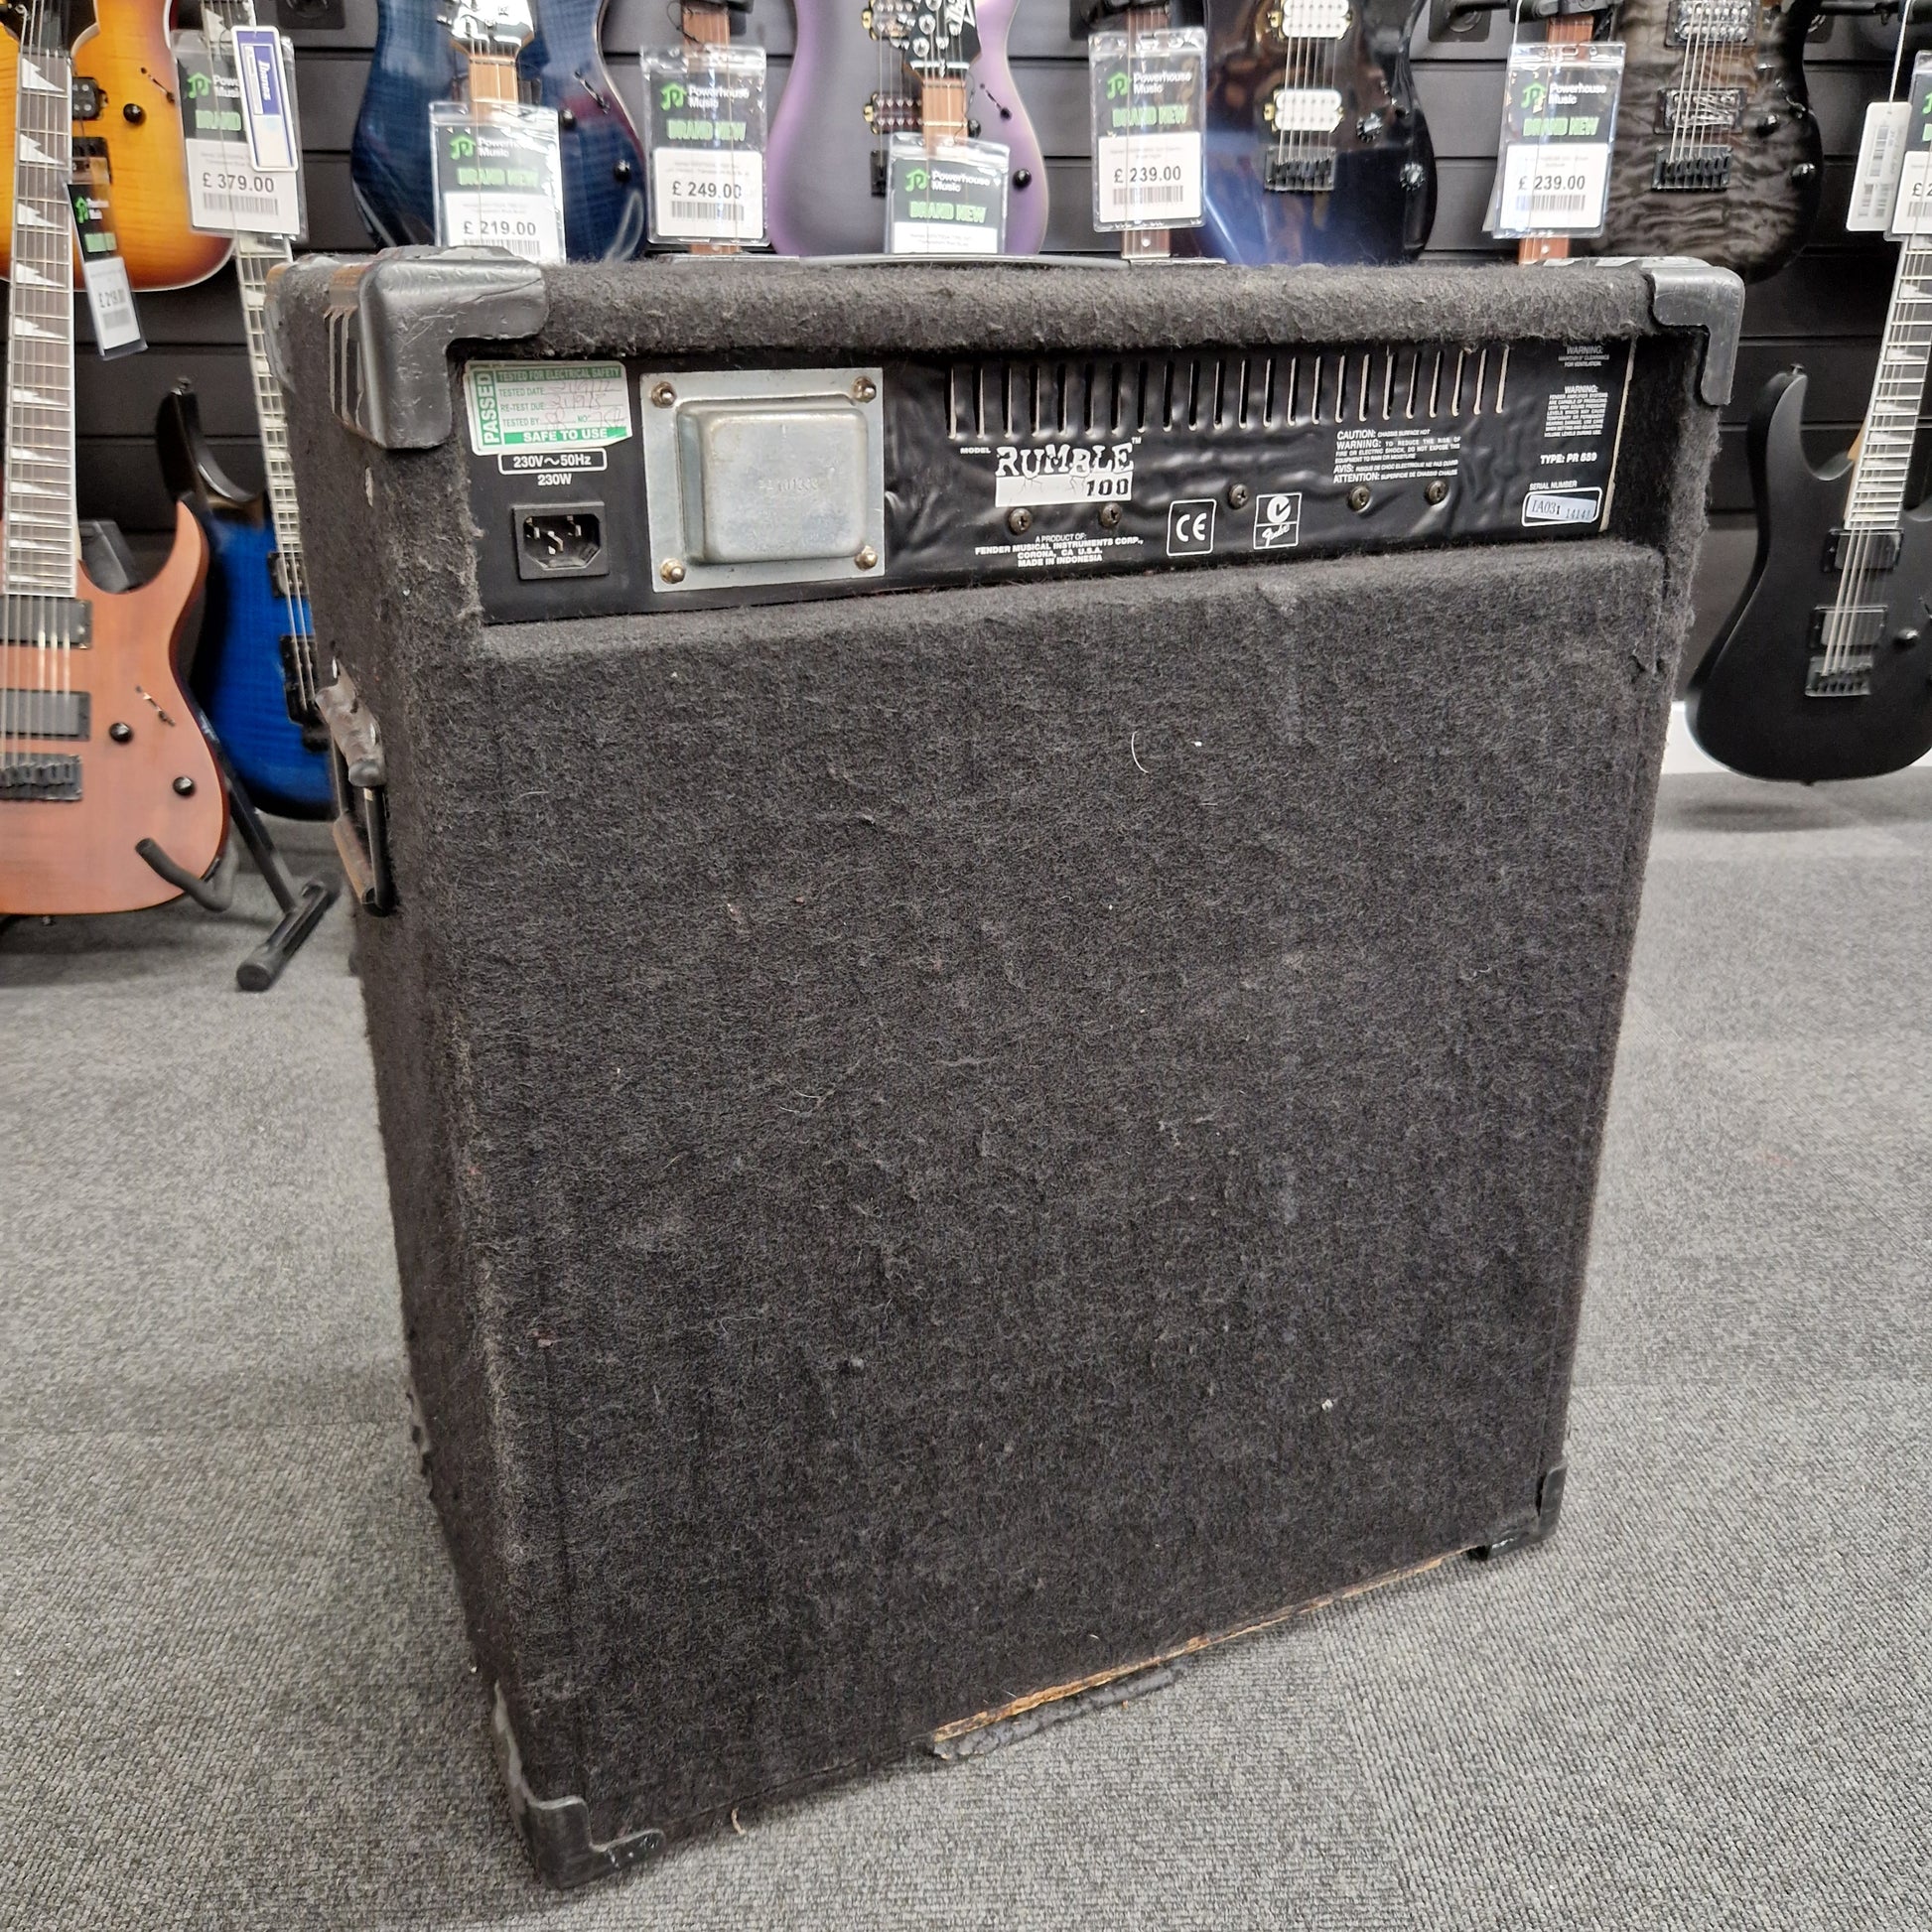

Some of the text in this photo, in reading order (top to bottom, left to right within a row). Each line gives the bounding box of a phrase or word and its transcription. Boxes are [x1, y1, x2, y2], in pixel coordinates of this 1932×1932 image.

[1133, 69, 1191, 83] Powerhouse
[213, 84, 240, 98] Musi
[688, 84, 750, 99] Powerhouse
[1133, 82, 1164, 94] Music
[1549, 82, 1607, 94] Powerhouse
[688, 96, 719, 109] Music
[1548, 93, 1578, 105] Music
[931, 169, 991, 187] Powerhouse
[1114, 166, 1181, 184] £ 239.00
[203, 172, 275, 193] £ 379.00
[931, 182, 961, 193] Music
[1534, 175, 1586, 191] 239.00
[672, 181, 743, 199] £ 249.00
[463, 220, 536, 236] £ 219.00
[497, 367, 620, 381] TESTED FOR ELECTRICAL SAFETY
[498, 386, 545, 397] TESTED DATE
[477, 372, 500, 443] PASSED
[500, 402, 545, 412] RE-TEST DUE
[502, 417, 539, 427] TESTED BY
[522, 427, 609, 443] SAFE TO USE
[1336, 429, 1376, 441] CAUTION:
[1336, 439, 1382, 451] WARNING:
[995, 442, 1135, 480] RUMBLE
[1540, 453, 1566, 465] TYPE:
[1566, 453, 1580, 464] PR
[1333, 463, 1354, 474] AVIS:
[537, 473, 573, 486] 230W
[1332, 472, 1380, 484] ATTENTION:
[1550, 480, 1578, 489] NUMBER
[1086, 478, 1130, 497] 100
[1041, 533, 1074, 542] PRODUCT
[975, 545, 1011, 555] FENDER
[1012, 542, 1051, 552] MUSICAL
[1053, 538, 1113, 550] INSTRUMENTS
[1077, 546, 1103, 555] U.S.A.
[1018, 554, 1103, 567] MADE IN INDONESIA
